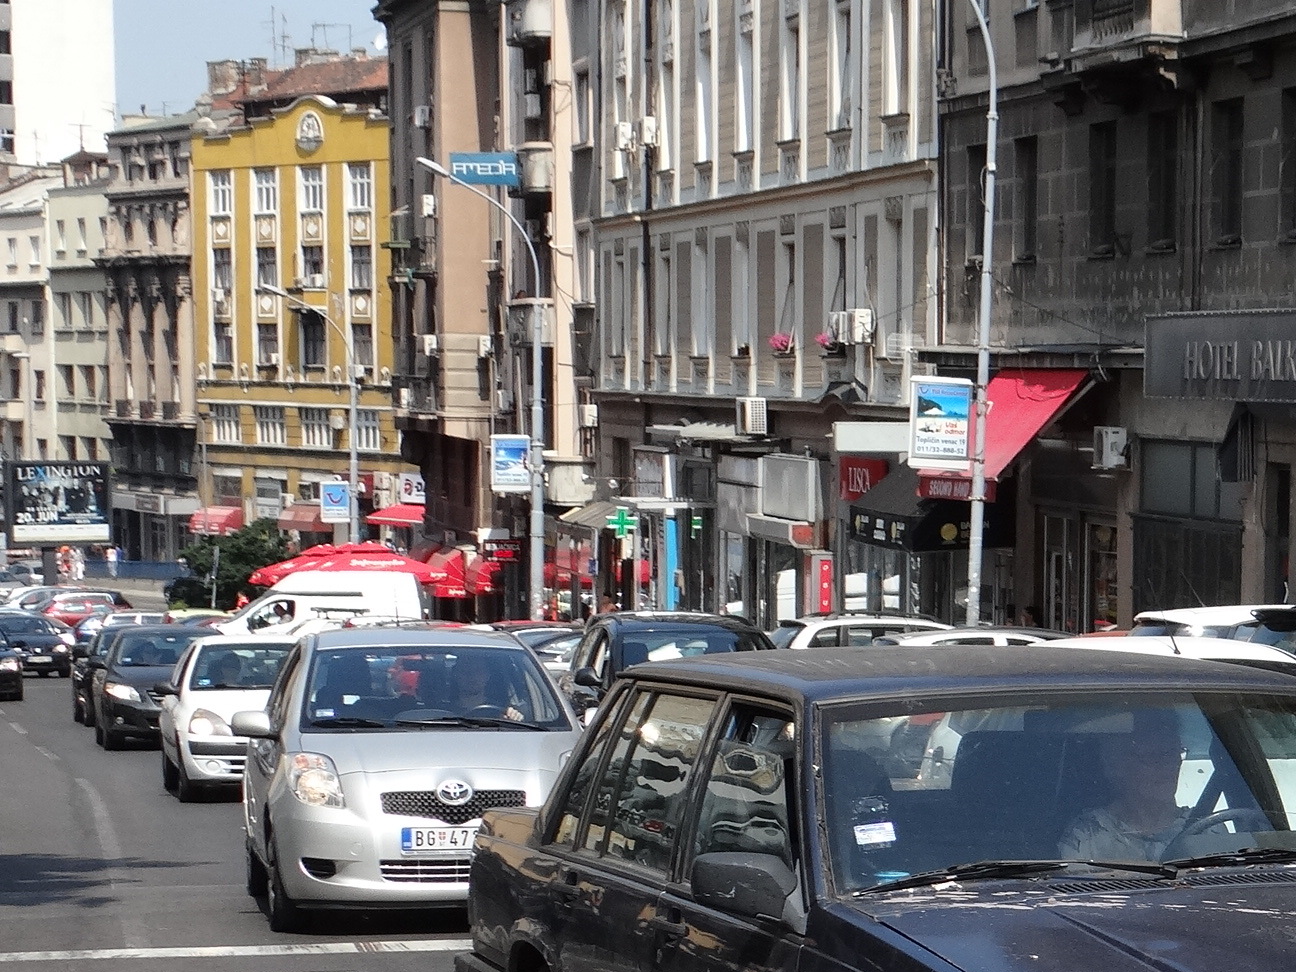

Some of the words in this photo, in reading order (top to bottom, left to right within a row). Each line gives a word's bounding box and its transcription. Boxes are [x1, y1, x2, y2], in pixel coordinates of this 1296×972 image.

[1185, 340, 1241, 380] HOTEL
[17, 466, 101, 481] LEXINGTON
[416, 831, 436, 847] BG
